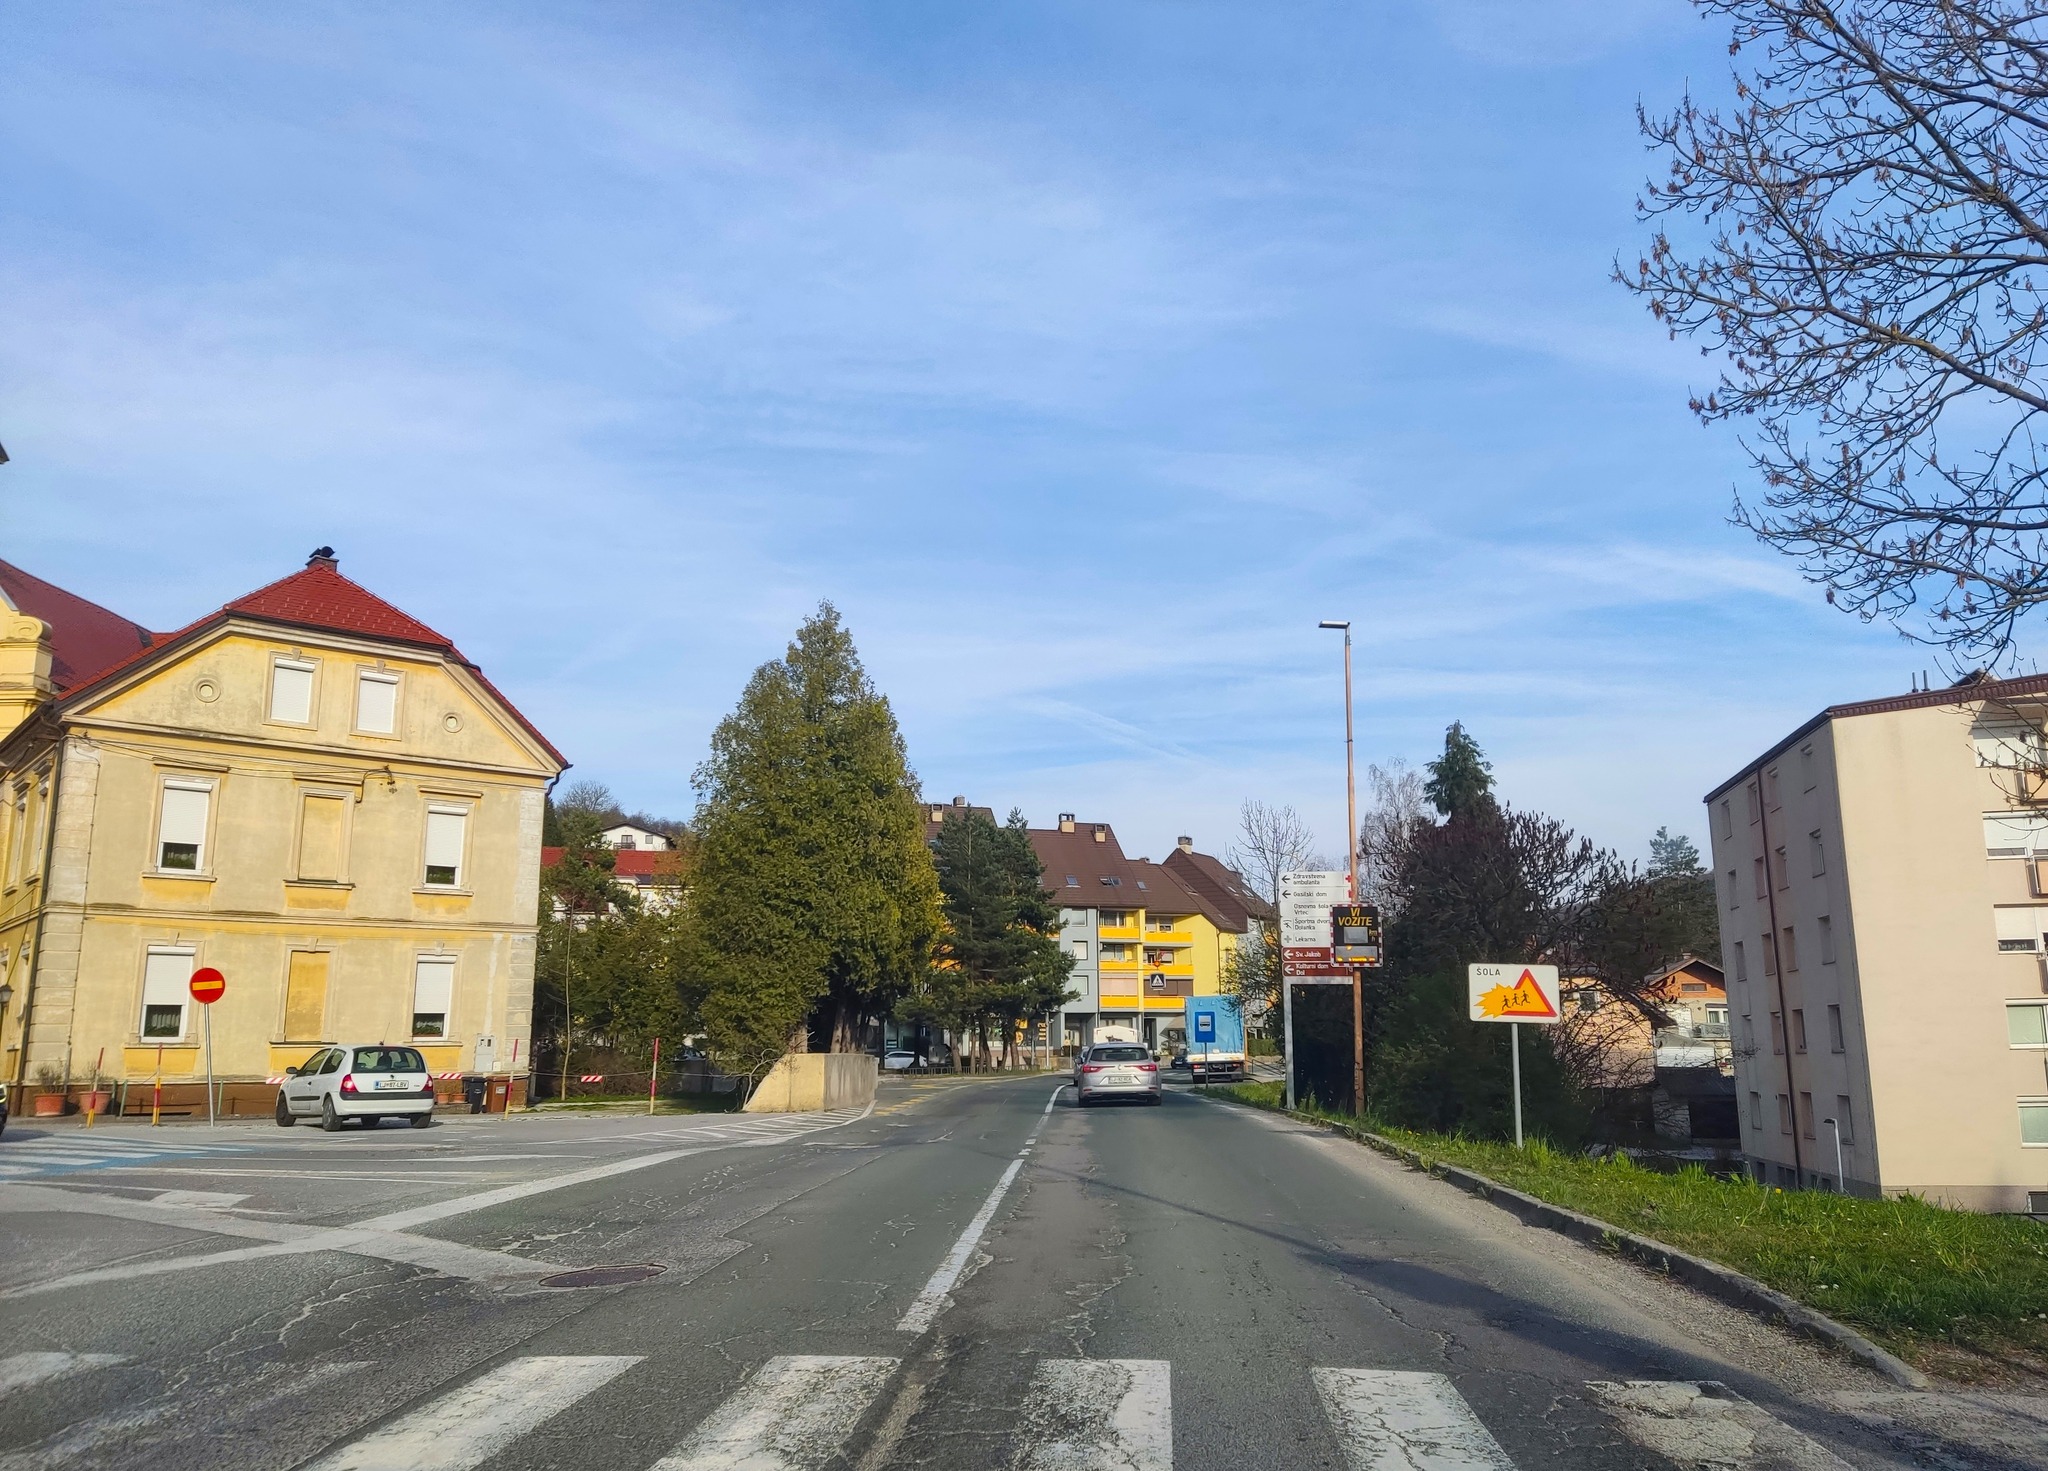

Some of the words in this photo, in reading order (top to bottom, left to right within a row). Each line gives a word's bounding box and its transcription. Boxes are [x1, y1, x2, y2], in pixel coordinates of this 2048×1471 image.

[1350, 908, 1360, 916] VI
[1338, 917, 1373, 926] VOZITE
[1476, 966, 1501, 976] ŠOLA
